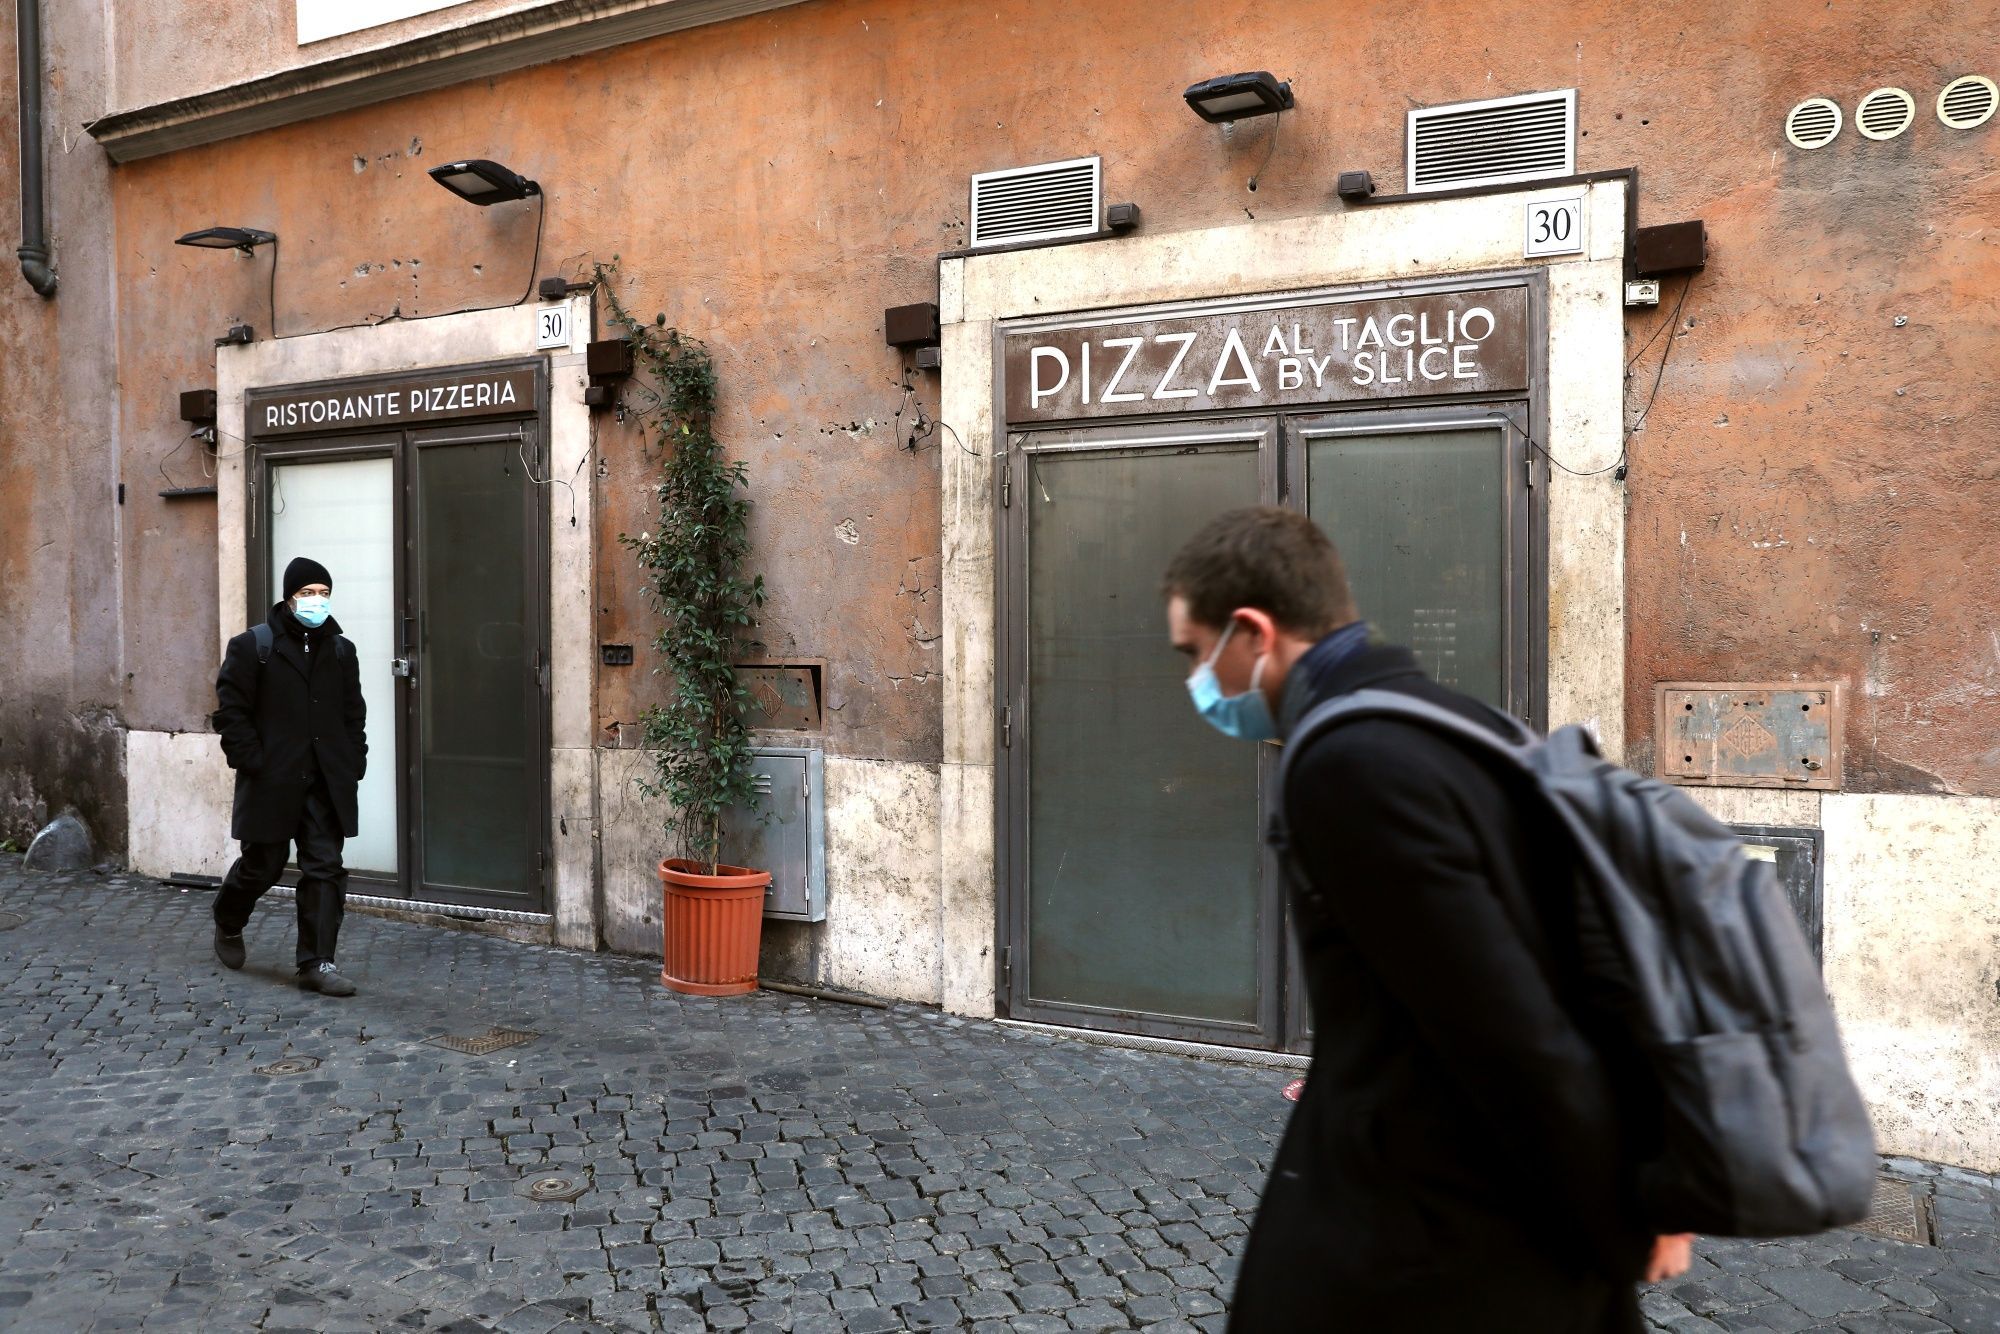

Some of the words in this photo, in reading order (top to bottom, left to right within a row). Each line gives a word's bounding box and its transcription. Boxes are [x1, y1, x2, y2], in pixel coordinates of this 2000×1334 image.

[541, 312, 563, 340] 30
[1261, 323, 1314, 358] AL
[1334, 307, 1495, 351] TAGLIO
[1030, 325, 1262, 409] PIZZA
[1278, 355, 1332, 391] BY
[1352, 344, 1479, 386] SLICE
[266, 392, 401, 427] RISTORANTE
[410, 379, 516, 413] PIZZERIA
